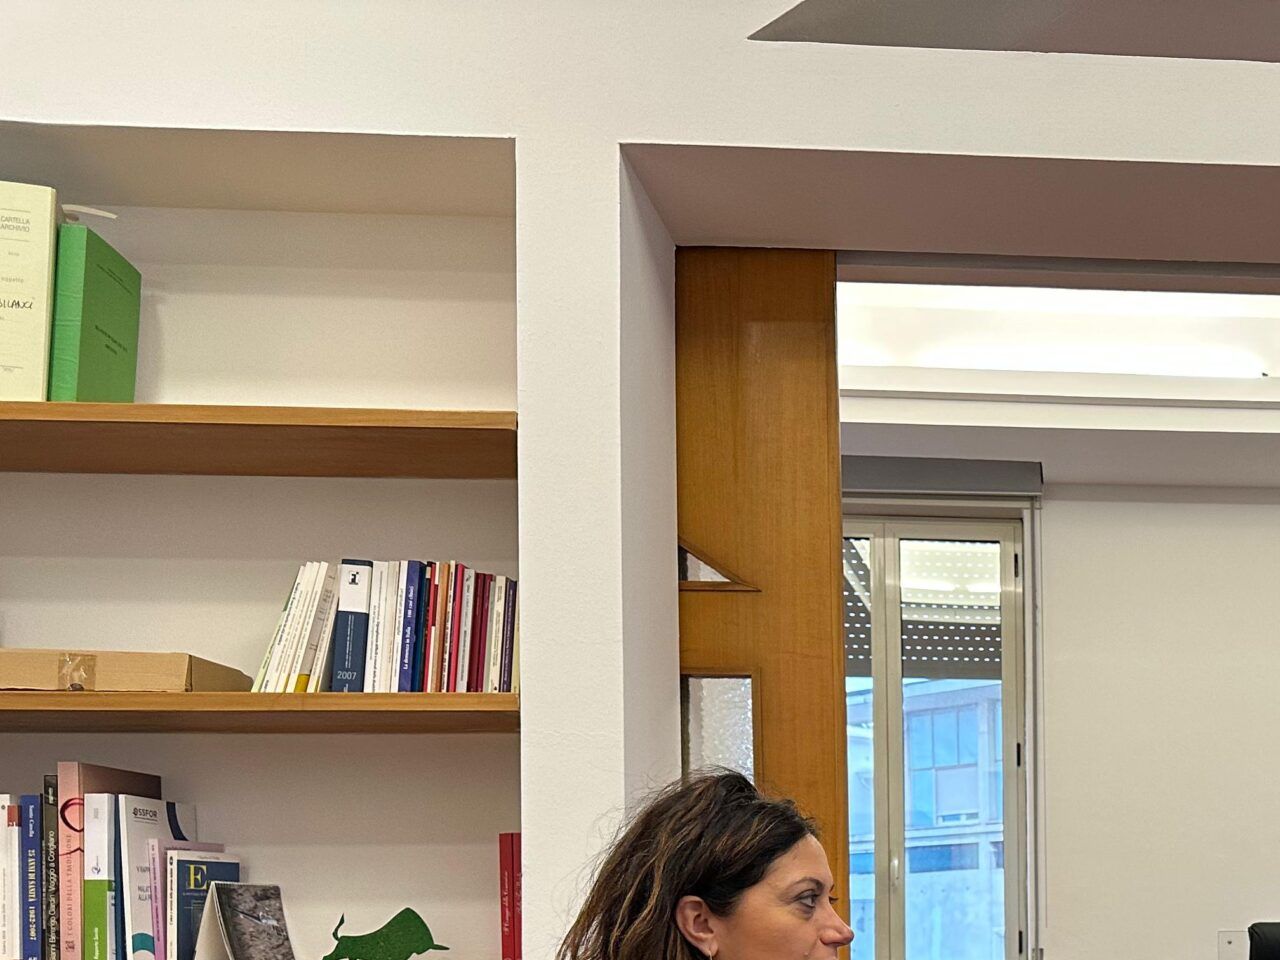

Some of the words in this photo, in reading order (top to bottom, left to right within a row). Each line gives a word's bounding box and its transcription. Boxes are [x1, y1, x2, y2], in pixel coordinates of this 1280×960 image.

[0, 216, 30, 225] CARTELLA
[0, 223, 30, 233] ARCHIVIO
[337, 671, 357, 681] 2007
